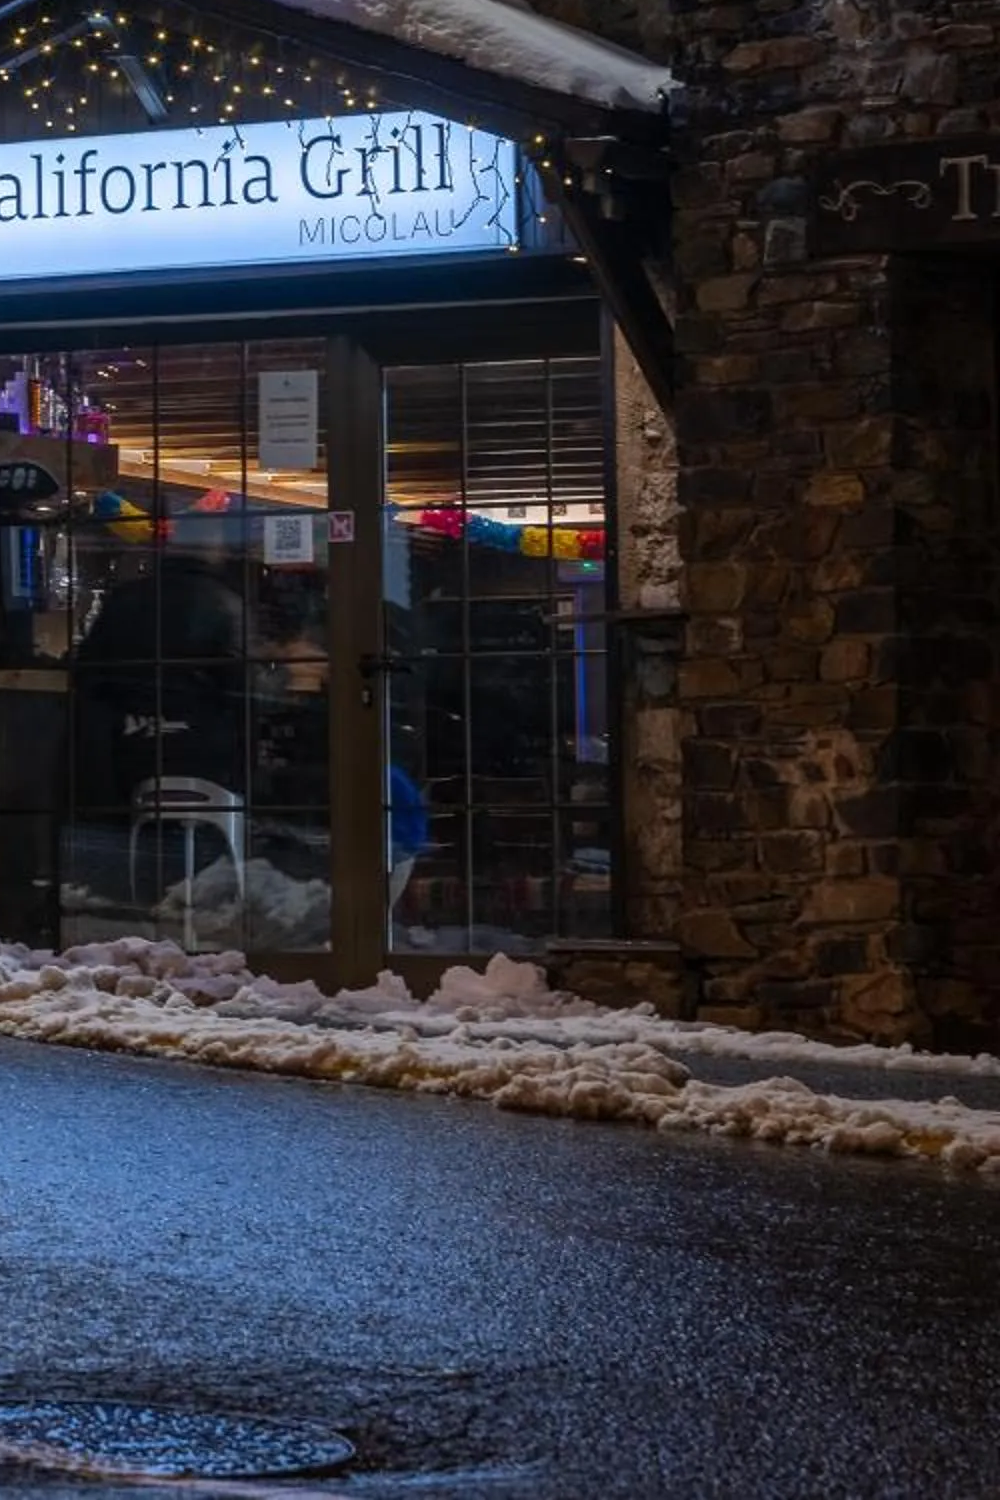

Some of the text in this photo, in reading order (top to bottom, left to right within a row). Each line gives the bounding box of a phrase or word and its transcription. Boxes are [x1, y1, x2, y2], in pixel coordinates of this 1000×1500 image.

[300, 122, 454, 200] Grill
[939, 153, 1000, 221] T
[299, 208, 455, 246] MICOLAU
